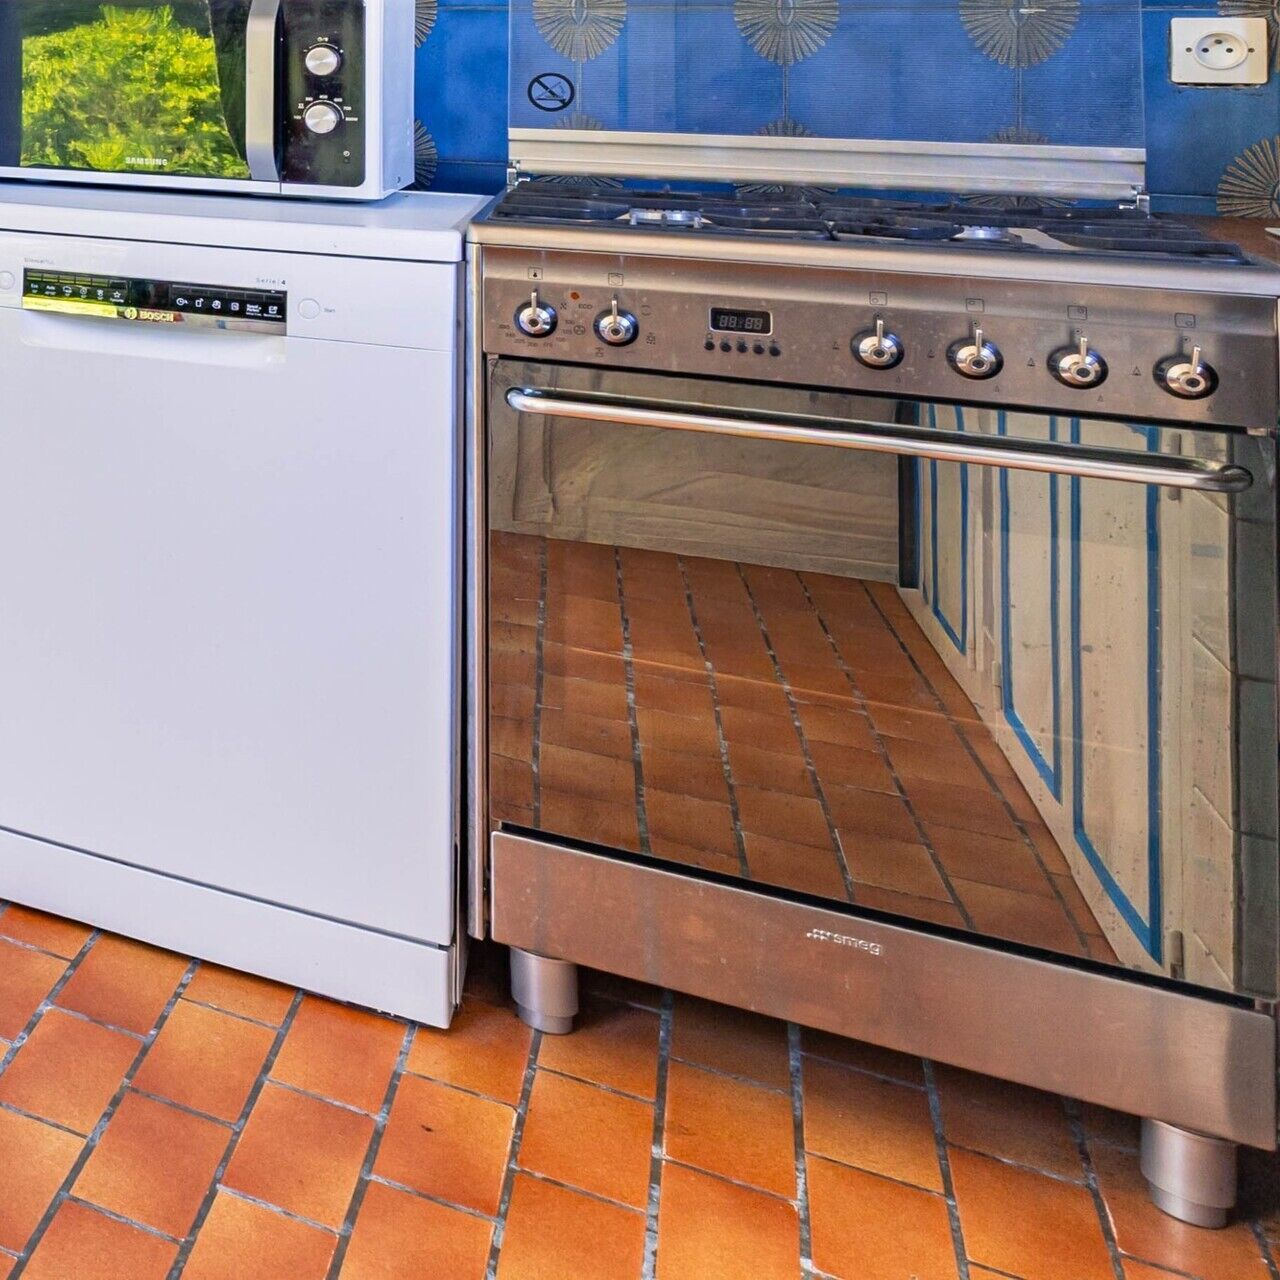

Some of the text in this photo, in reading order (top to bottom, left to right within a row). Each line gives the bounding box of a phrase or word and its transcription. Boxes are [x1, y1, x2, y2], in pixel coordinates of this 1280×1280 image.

[124, 156, 169, 166] SAMSUNG
[139, 310, 174, 322] BOSCH
[833, 933, 881, 957] smeg
